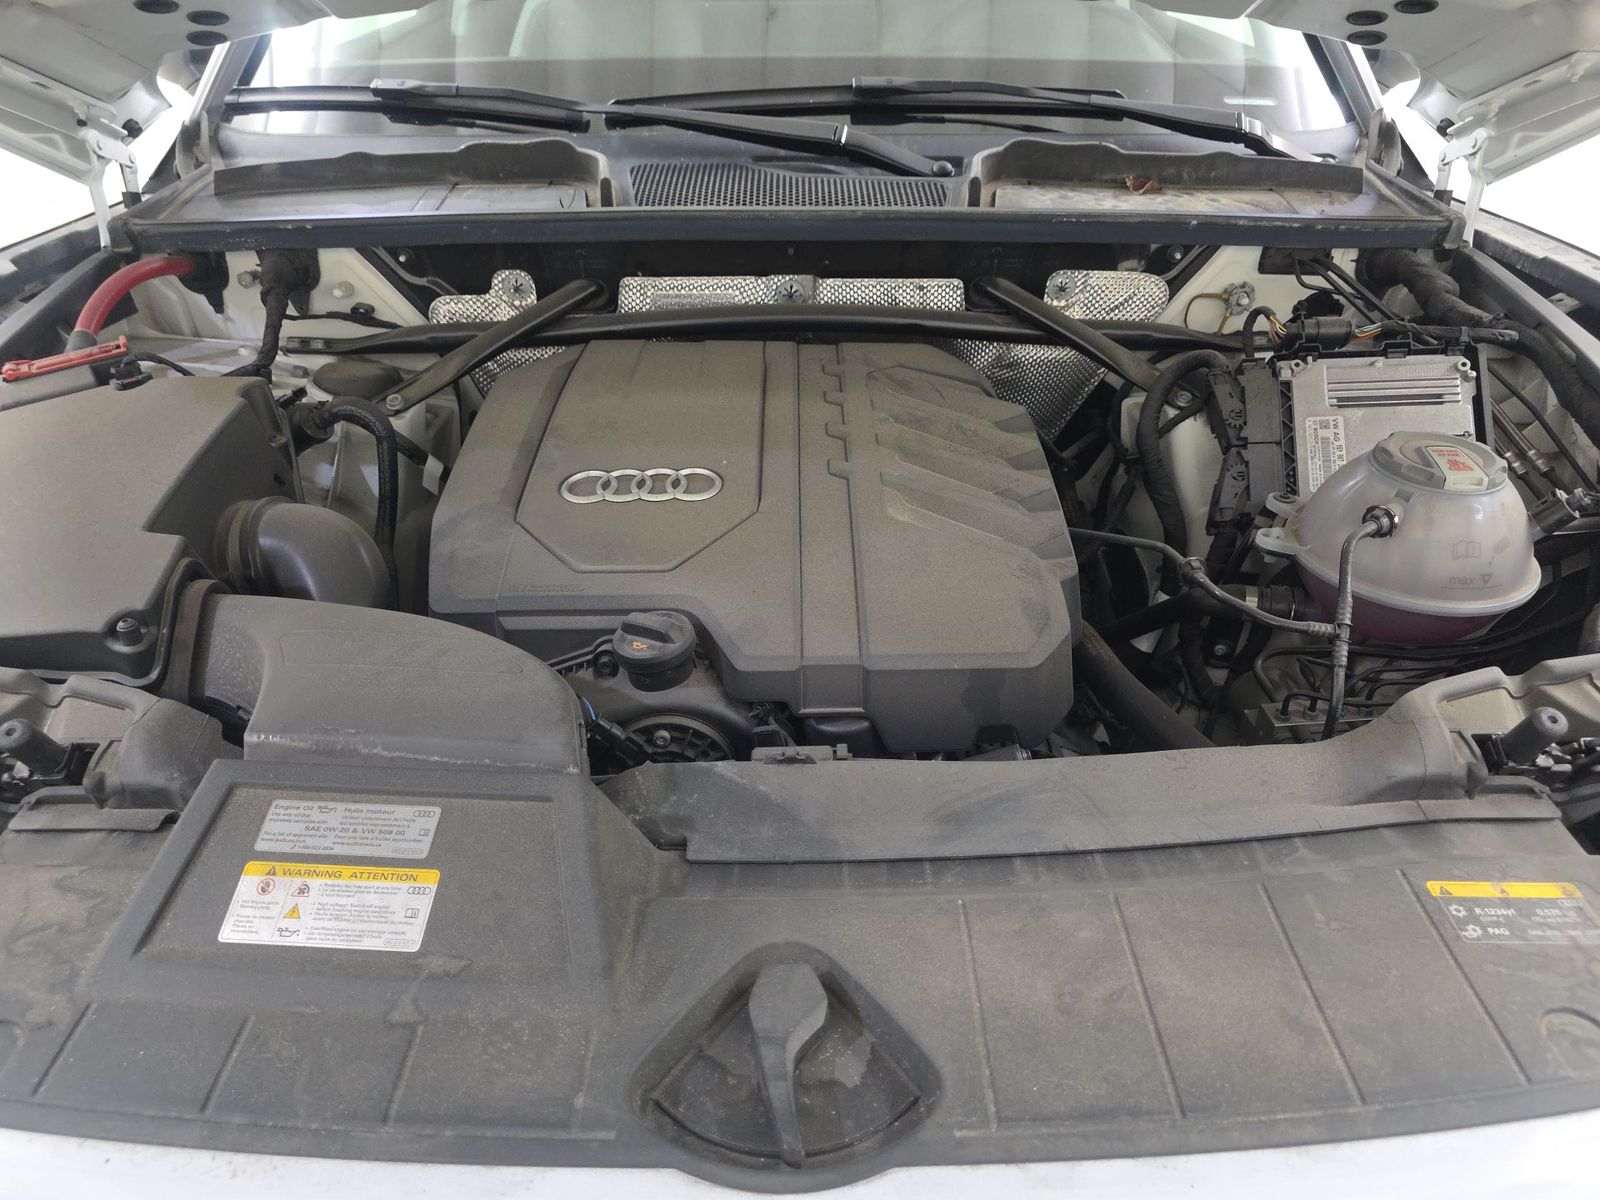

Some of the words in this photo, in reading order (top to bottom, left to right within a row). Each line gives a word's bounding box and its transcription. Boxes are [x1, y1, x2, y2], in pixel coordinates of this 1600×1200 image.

[1332, 418, 1338, 429] VW
[1333, 431, 1340, 442] AG
[1448, 576, 1475, 585] max
[281, 868, 343, 878] WARNING
[349, 871, 419, 882] ATTENTION
[1474, 907, 1515, 917] R-1234yf
[1486, 927, 1510, 936] PAG
